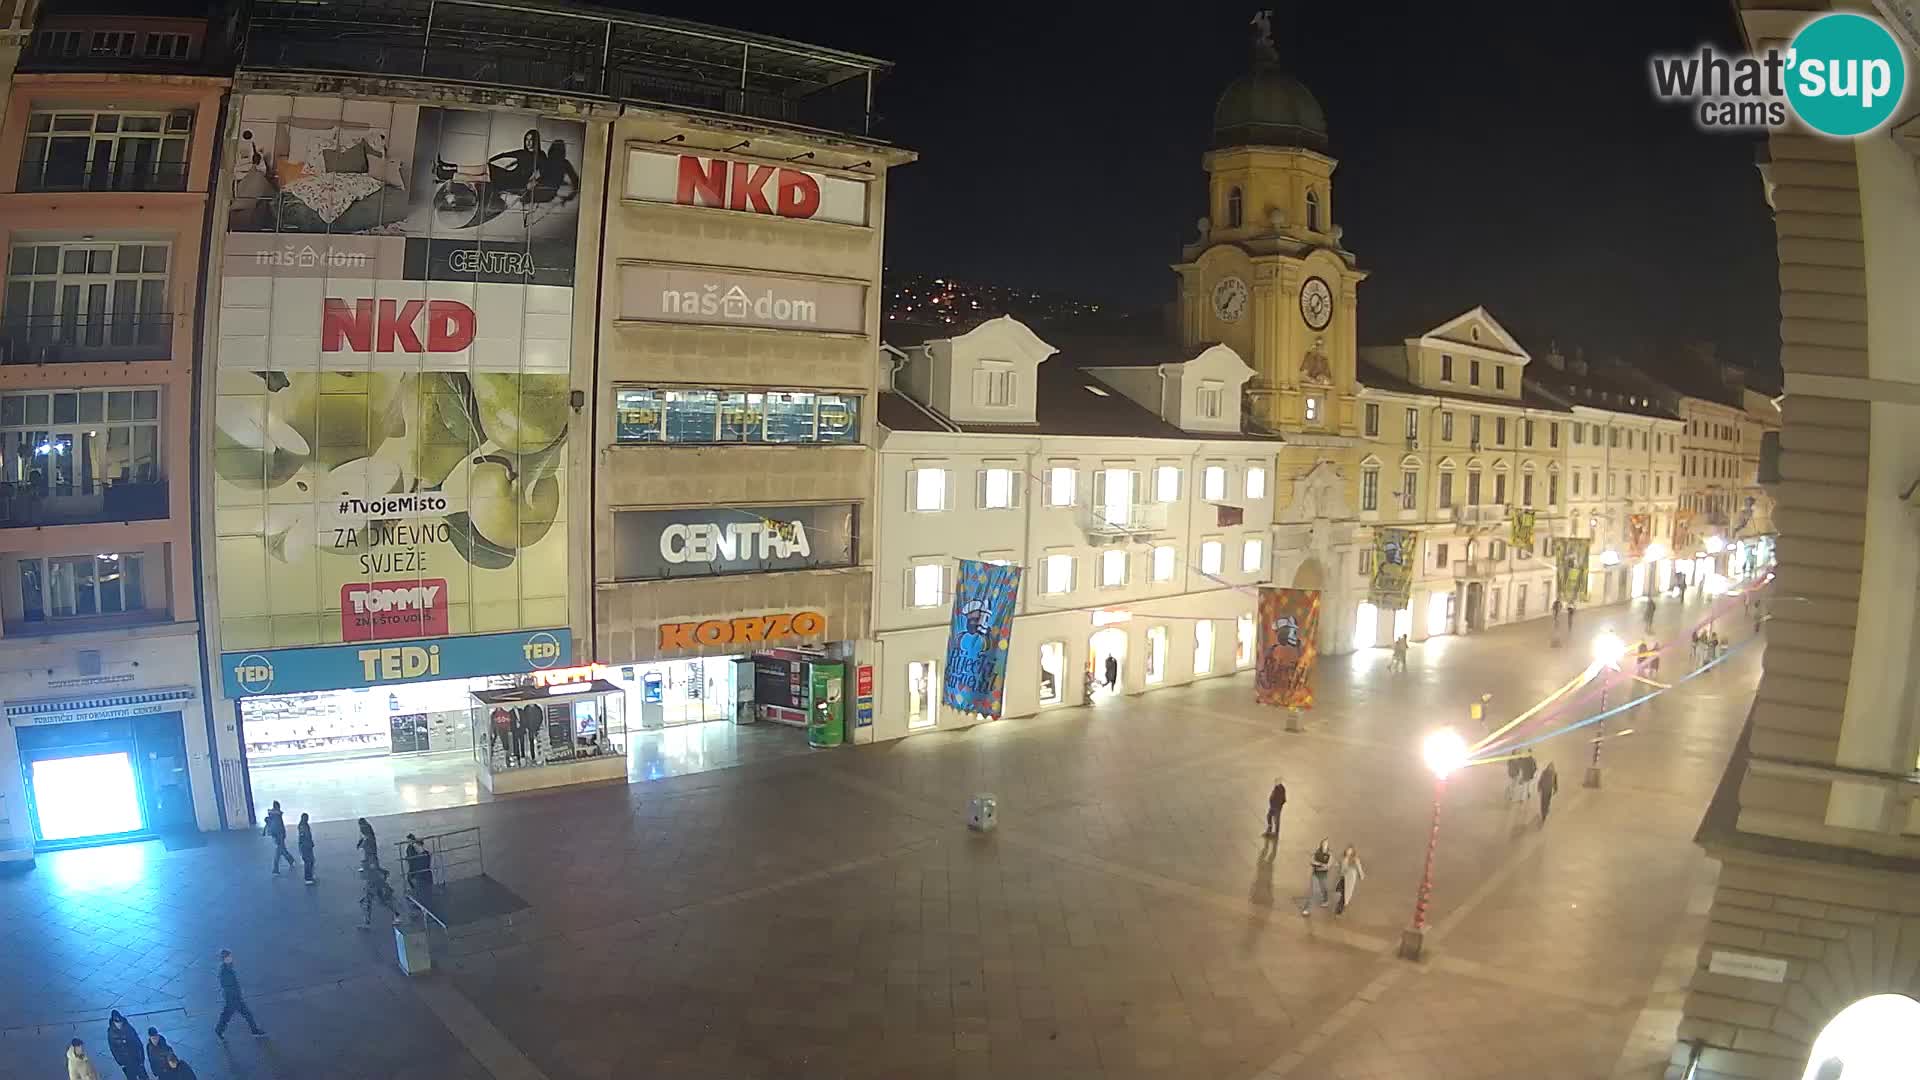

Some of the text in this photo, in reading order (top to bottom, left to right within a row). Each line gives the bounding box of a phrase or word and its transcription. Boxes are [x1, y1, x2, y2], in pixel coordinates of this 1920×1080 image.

[677, 155, 820, 219] NKD
[256, 246, 367, 268] naš dom
[449, 250, 536, 276] CENTRA
[662, 284, 816, 322] naš dom
[322, 297, 477, 353] NKD
[339, 497, 446, 516] #TvojeMisto
[334, 523, 451, 548] ZA DNEVNO
[660, 520, 811, 563] CENTRA
[360, 546, 427, 575] SVJEŽE
[349, 586, 440, 614] TOMMY
[659, 612, 827, 650] KORZO
[358, 644, 440, 681] TEDi
[522, 642, 560, 660] TEDi
[234, 665, 274, 683] TEDi
